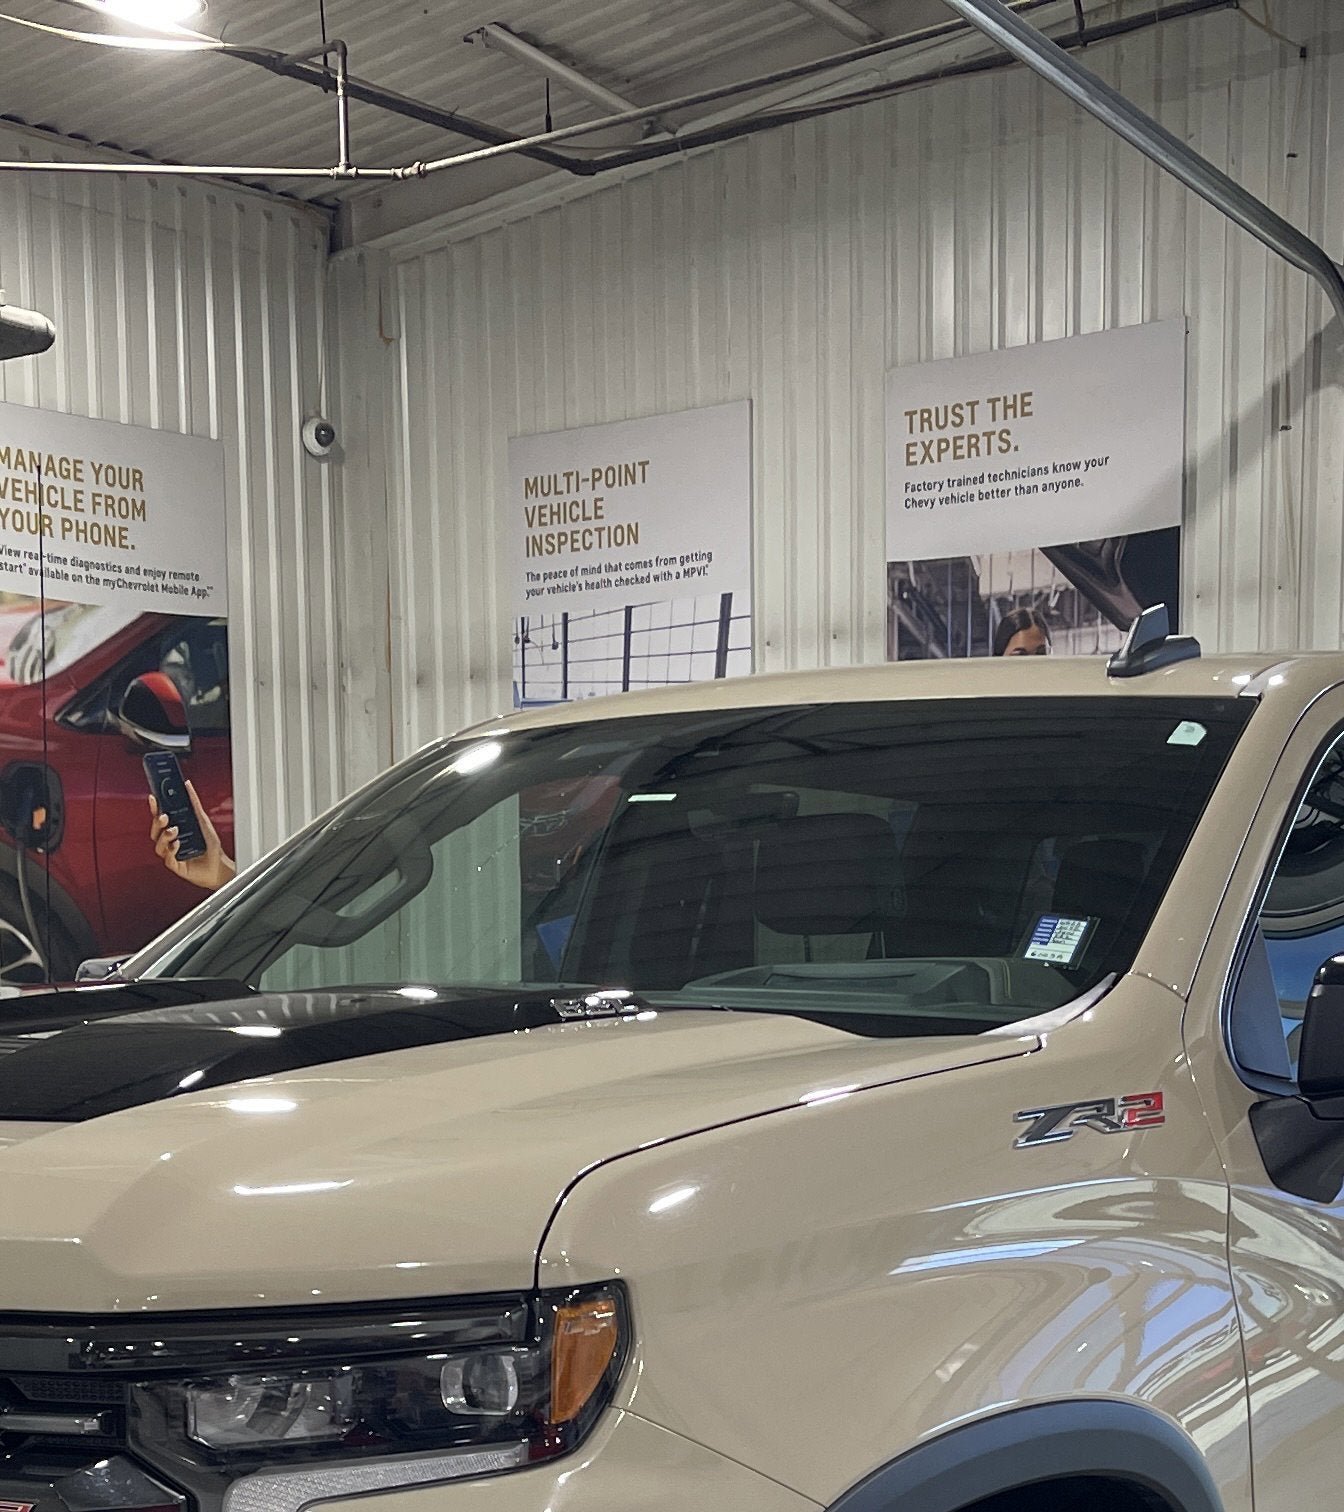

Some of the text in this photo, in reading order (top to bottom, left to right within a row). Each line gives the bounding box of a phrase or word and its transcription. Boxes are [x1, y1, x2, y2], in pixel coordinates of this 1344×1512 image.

[904, 391, 1034, 434] TRUST THE
[905, 428, 1019, 467] EXPERTS.
[90, 461, 145, 492] YOUR
[524, 460, 650, 500] MULTI-POINT
[904, 456, 1110, 494] Factory trained technicians know your
[91, 492, 147, 522] FROM
[524, 497, 605, 528] VEHICLE
[904, 498, 935, 510] Chevy
[938, 490, 975, 506] vehicle
[978, 487, 1011, 501] better
[1014, 483, 1039, 496] than
[61, 517, 136, 550] PHONE.
[525, 522, 640, 558] INSPECTION
[23, 548, 68, 566] rea-time
[70, 556, 122, 574] diagnostics
[125, 563, 141, 576] and
[143, 567, 167, 580] enjoy
[169, 570, 200, 582] remote
[526, 550, 713, 583] The peace of mind that comes from getting
[71, 572, 83, 582] on
[86, 574, 100, 586] the
[103, 576, 160, 593] myChevrolet
[161, 583, 189, 596] Mobile
[525, 587, 545, 600] your
[547, 580, 583, 595] vehicle's
[584, 578, 612, 592] health
[614, 572, 651, 587] checked
[653, 570, 673, 582] with
[1013, 1091, 1166, 1148] ZR2
